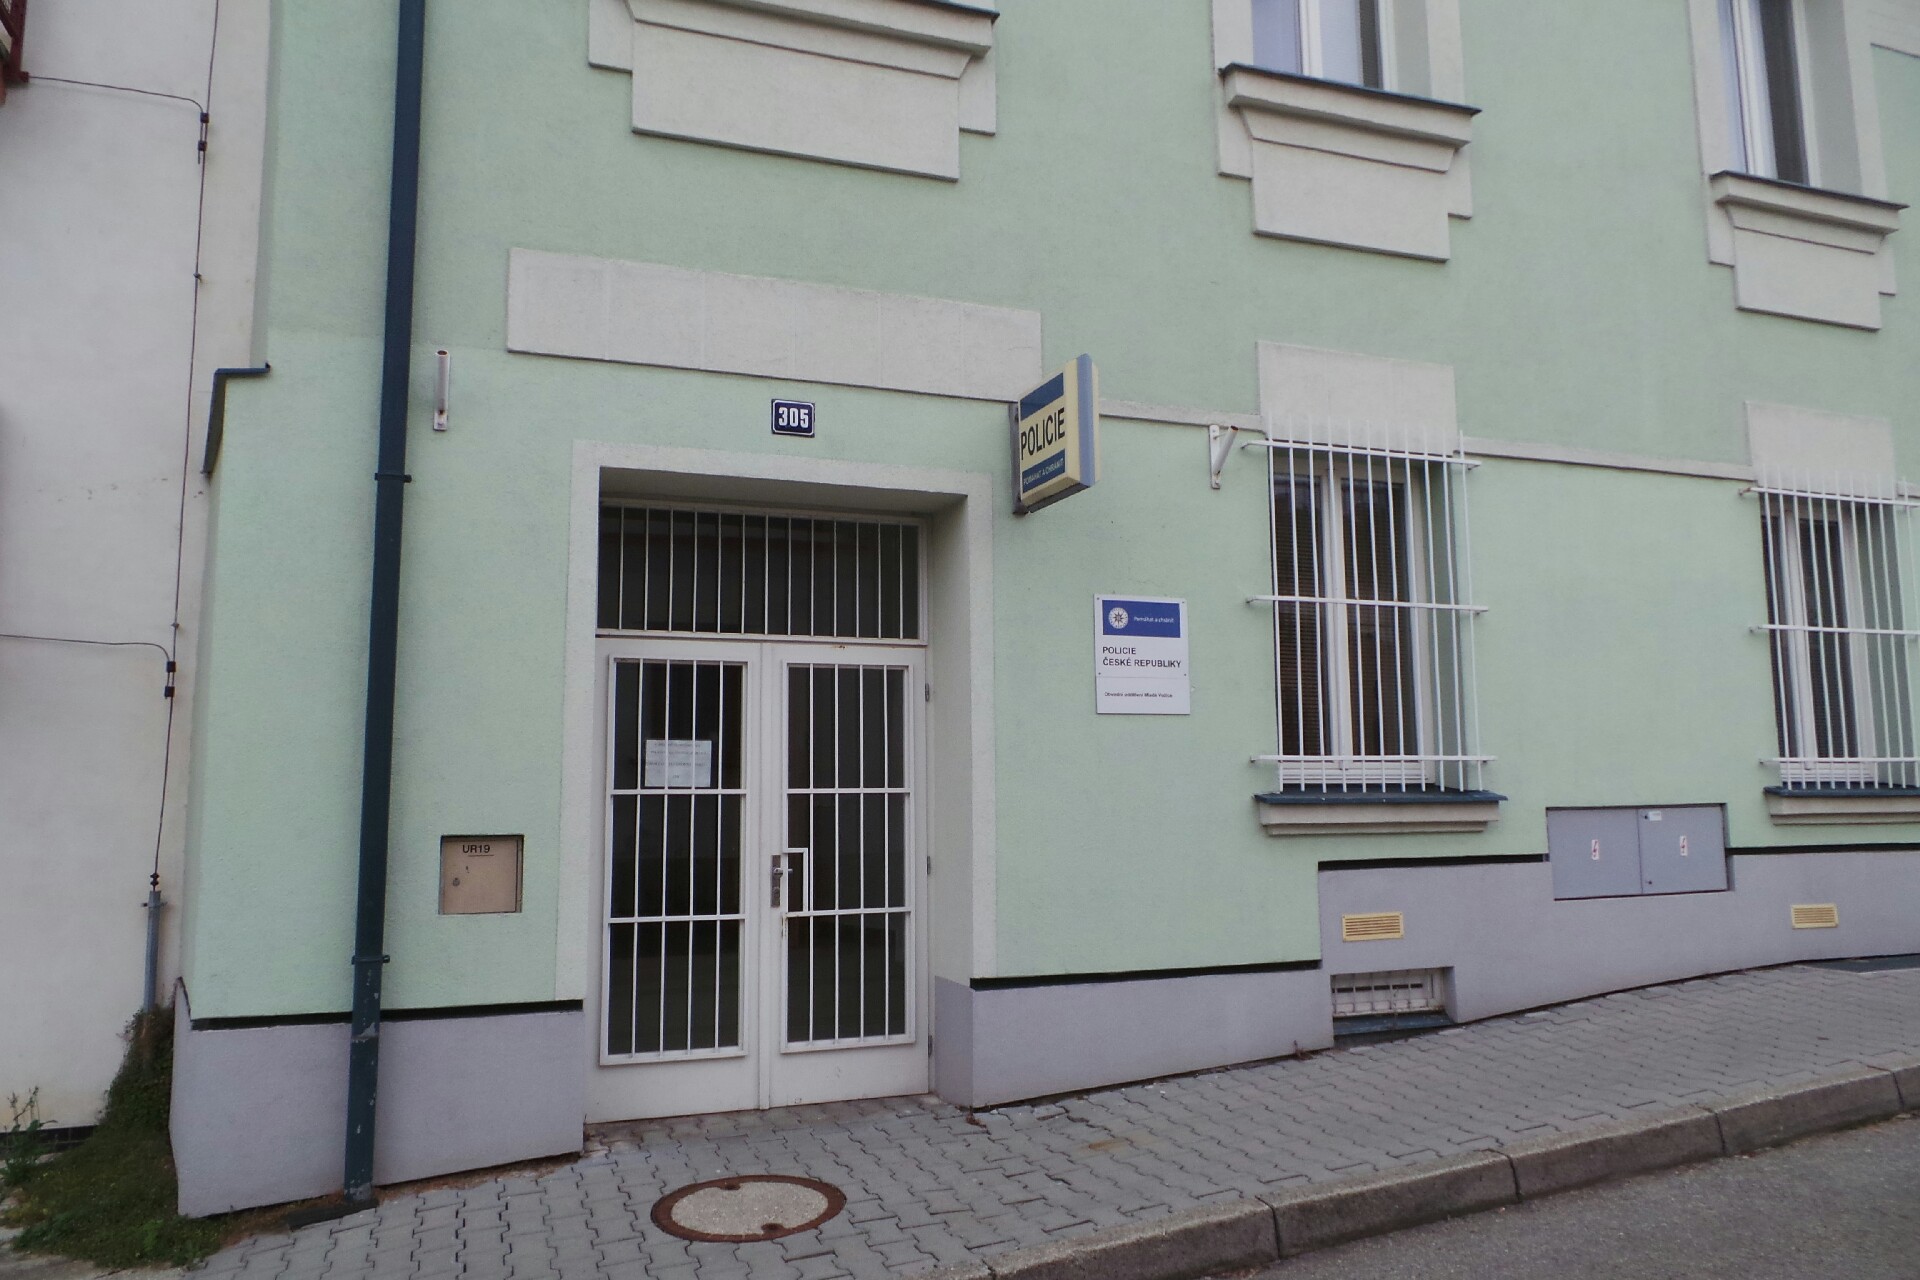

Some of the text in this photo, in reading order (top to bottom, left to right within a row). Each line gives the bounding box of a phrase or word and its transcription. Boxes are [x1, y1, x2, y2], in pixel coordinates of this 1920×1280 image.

[778, 406, 809, 429] 305
[1020, 406, 1066, 461] POLICIE
[1102, 646, 1137, 655] POLICIE
[1102, 657, 1182, 669] ČESKÉ REPUBLIKY
[462, 844, 491, 854] UR19
